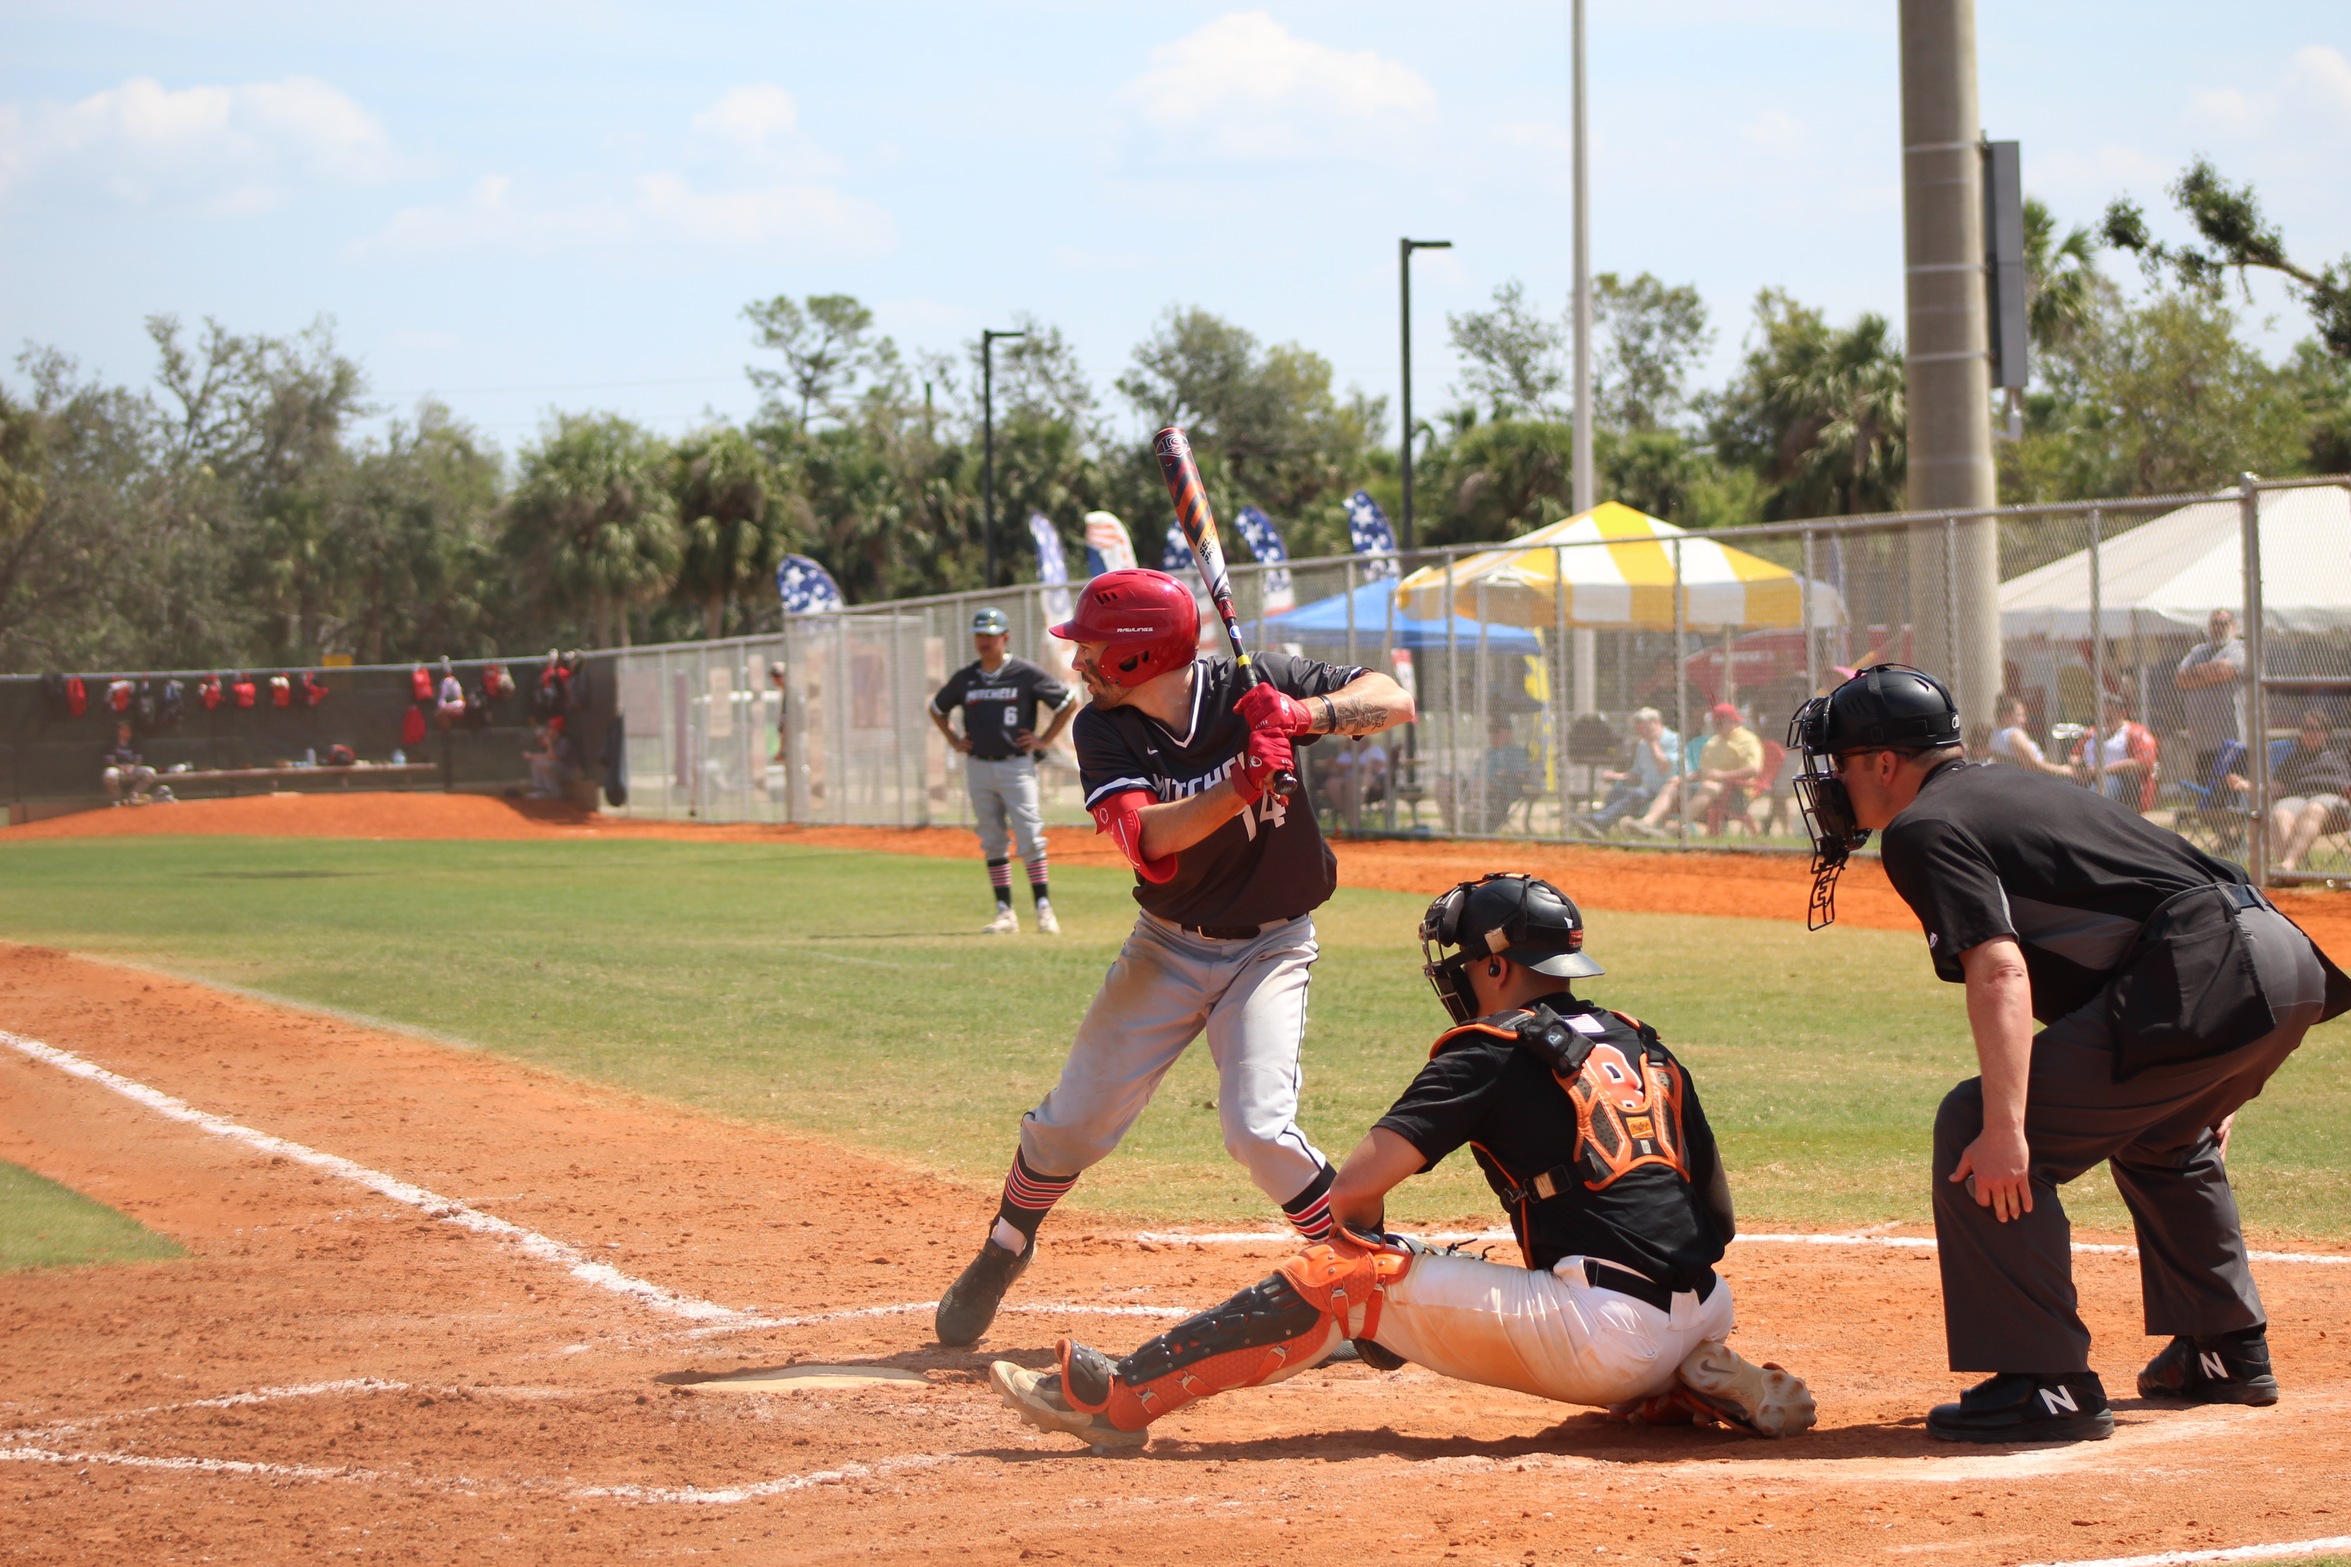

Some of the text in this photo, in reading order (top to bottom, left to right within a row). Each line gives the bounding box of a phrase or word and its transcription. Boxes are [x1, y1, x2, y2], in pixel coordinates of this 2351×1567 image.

[1003, 706, 1018, 727] 6
[1235, 786, 1286, 842] 14
[2199, 1352, 2229, 1379] N
[2038, 1384, 2079, 1415] N
